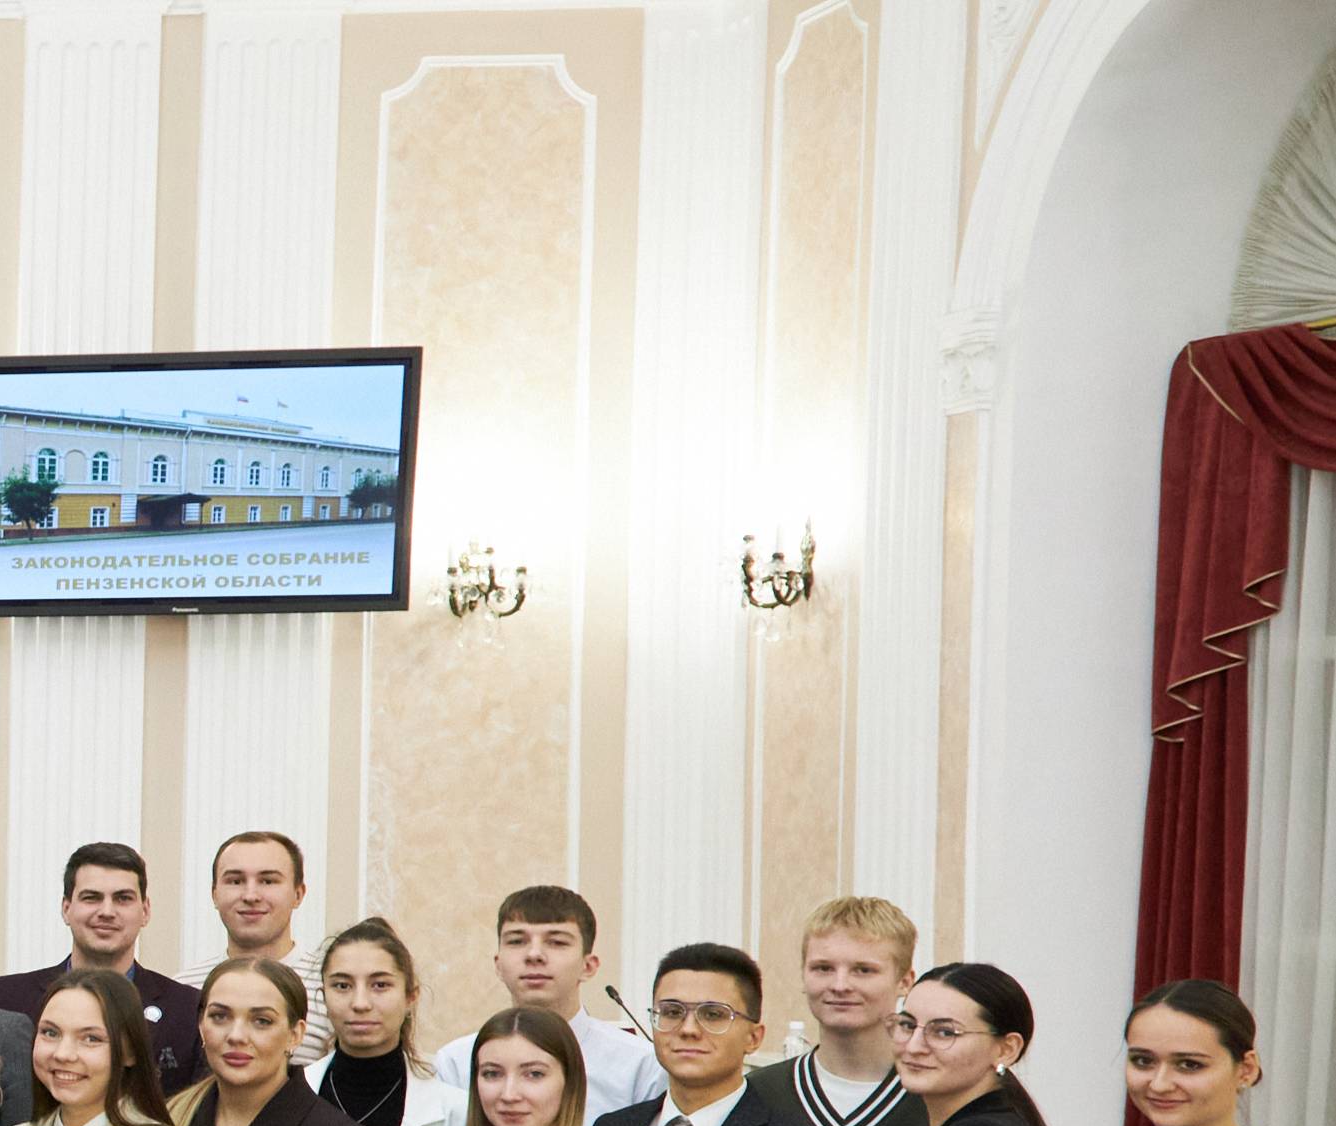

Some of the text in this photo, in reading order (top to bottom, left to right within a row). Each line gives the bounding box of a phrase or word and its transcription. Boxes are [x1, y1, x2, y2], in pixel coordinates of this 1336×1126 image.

[11, 551, 371, 571] ЗАКОНОДАТЕЛЬНОЕ СОБРАНИЕ
[55, 573, 323, 591] ПЕНЗЕНСКОЙ ОБЛАСТИ
